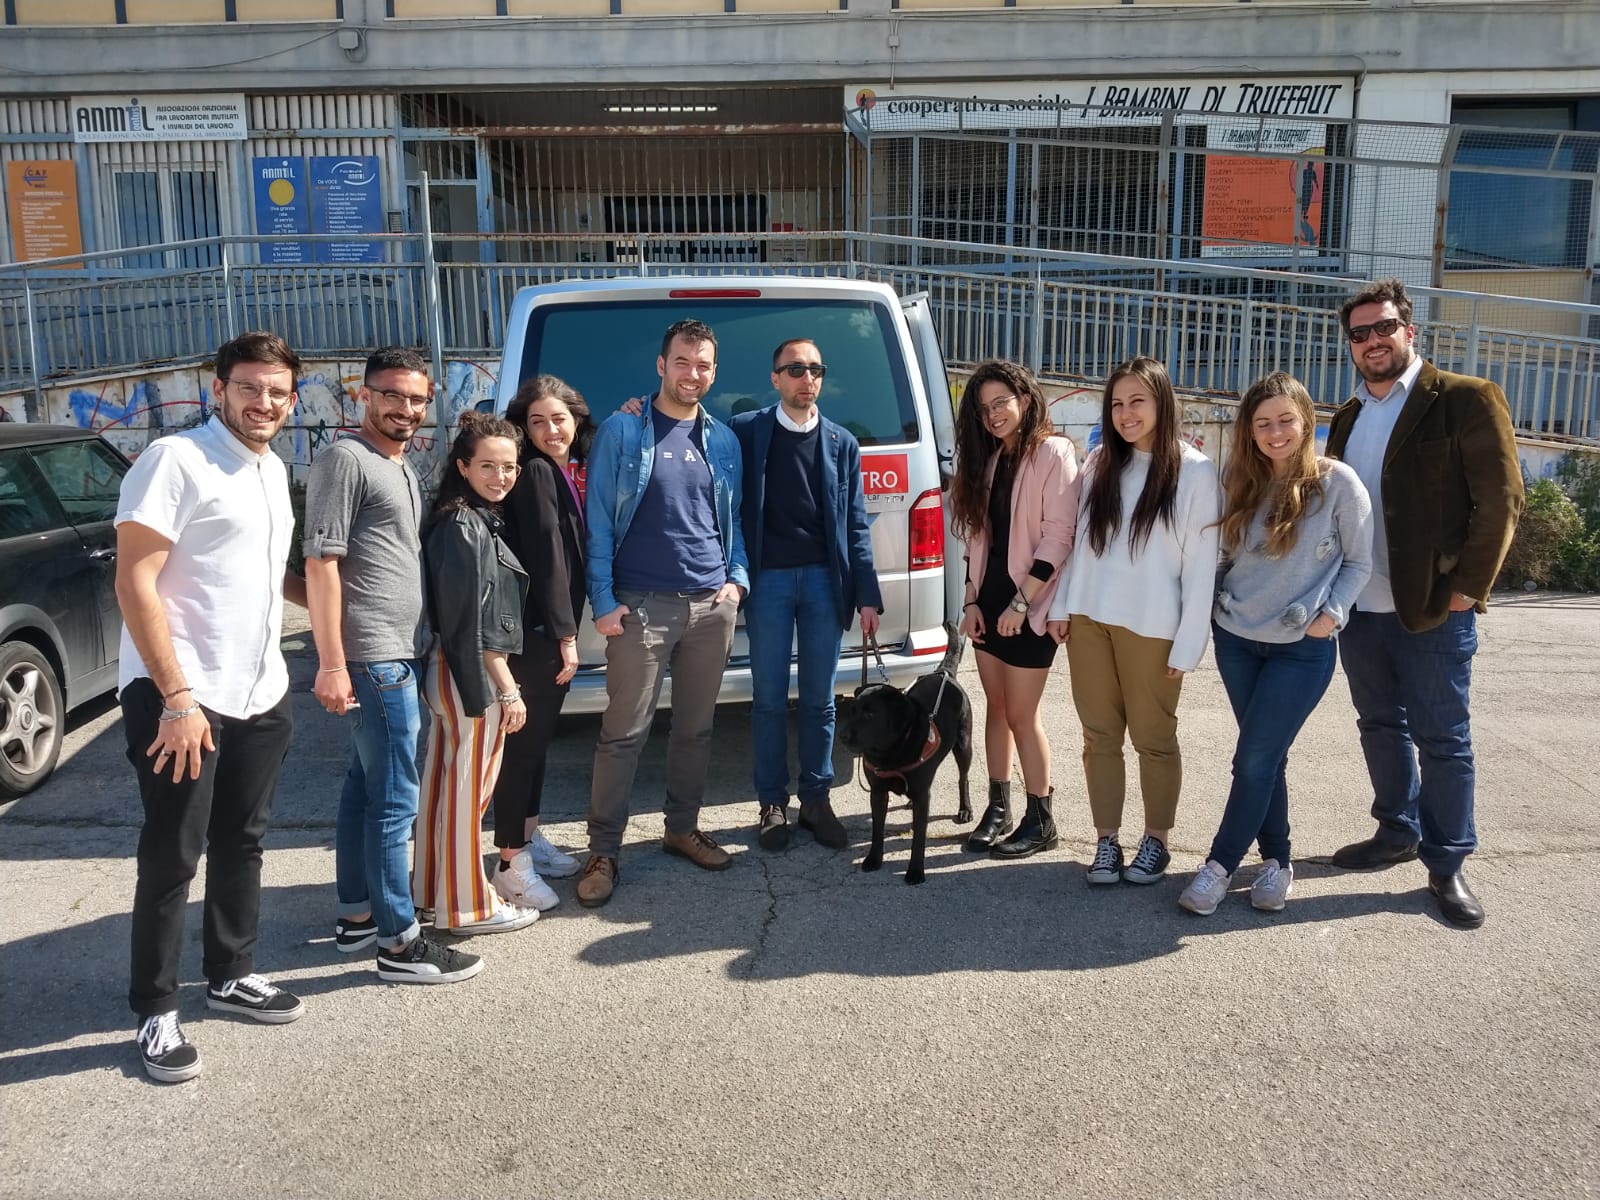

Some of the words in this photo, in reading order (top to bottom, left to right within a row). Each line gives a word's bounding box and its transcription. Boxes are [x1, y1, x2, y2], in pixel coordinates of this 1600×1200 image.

[887, 95, 1000, 118] cooperativa
[1005, 94, 1072, 113] sociale
[1099, 86, 1191, 118] BAMBINI
[1200, 86, 1227, 112] DI
[1235, 83, 1342, 115] TRUFFAUT
[207, 122, 235, 130] LAVORO
